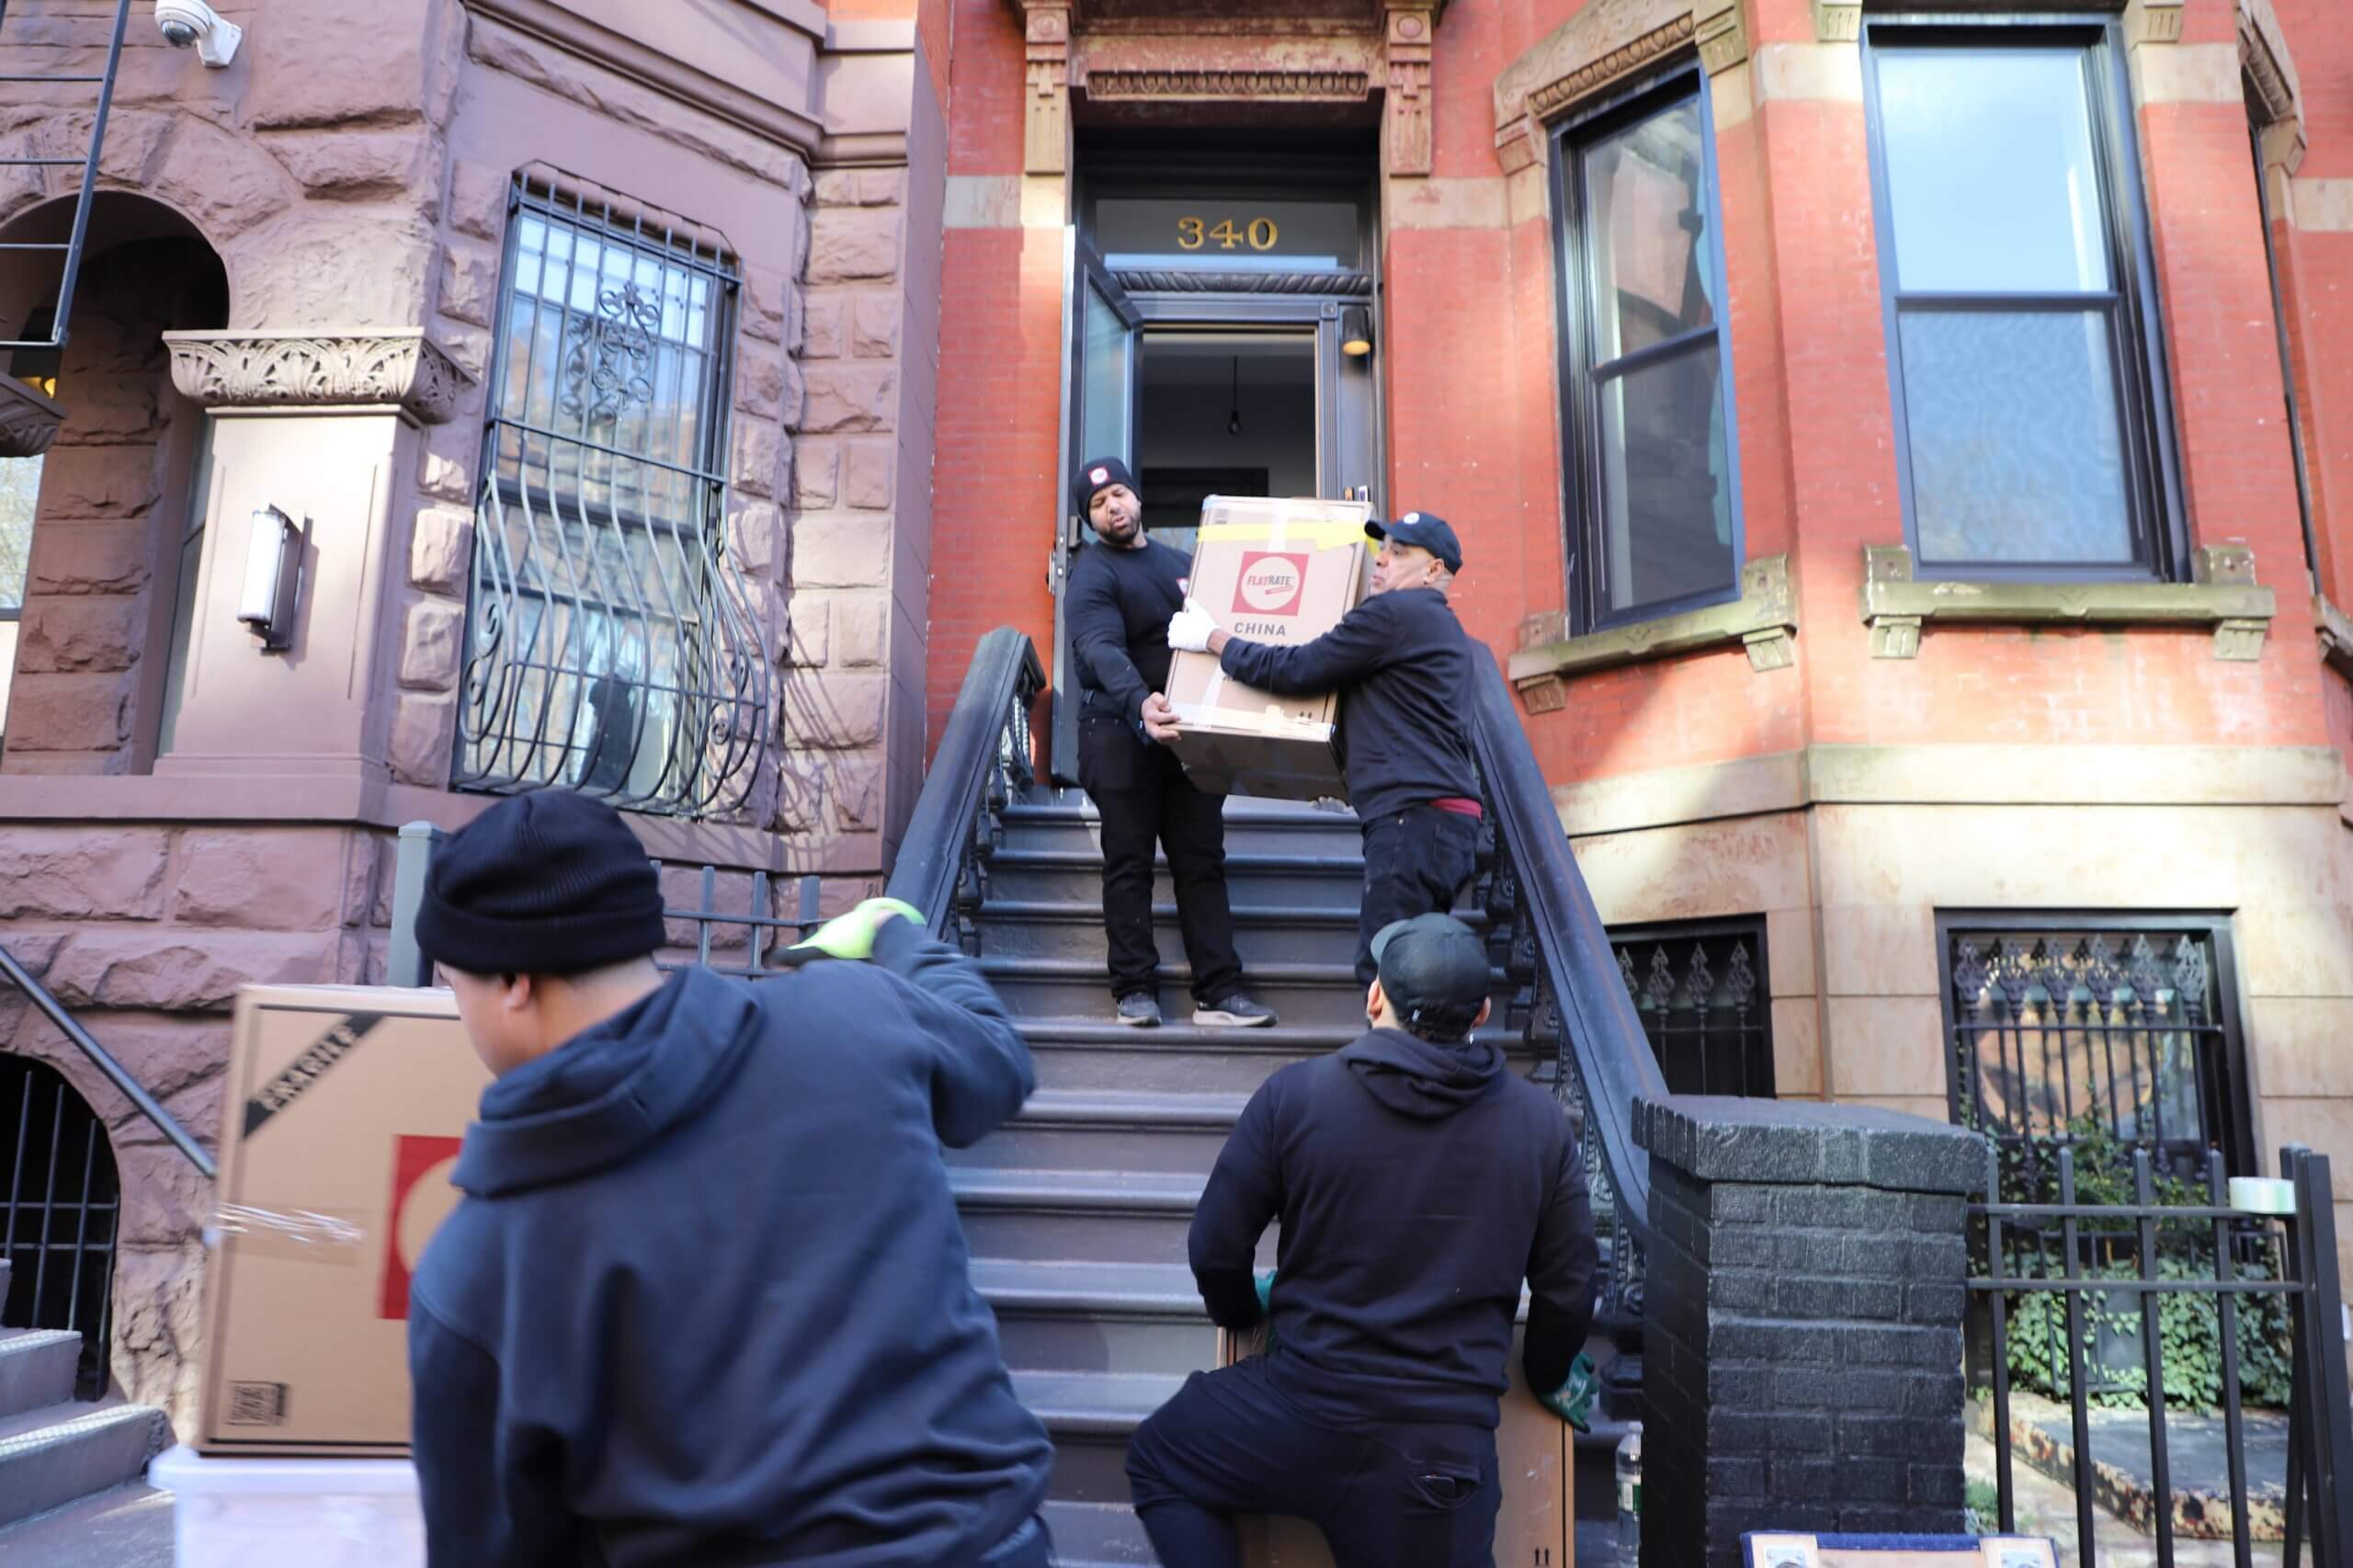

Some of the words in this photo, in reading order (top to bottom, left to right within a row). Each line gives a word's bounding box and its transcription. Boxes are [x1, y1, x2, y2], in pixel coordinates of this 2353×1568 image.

[1177, 216, 1279, 250] 340
[1246, 574, 1291, 586] FLATRATE
[1234, 622, 1286, 636] CHINA
